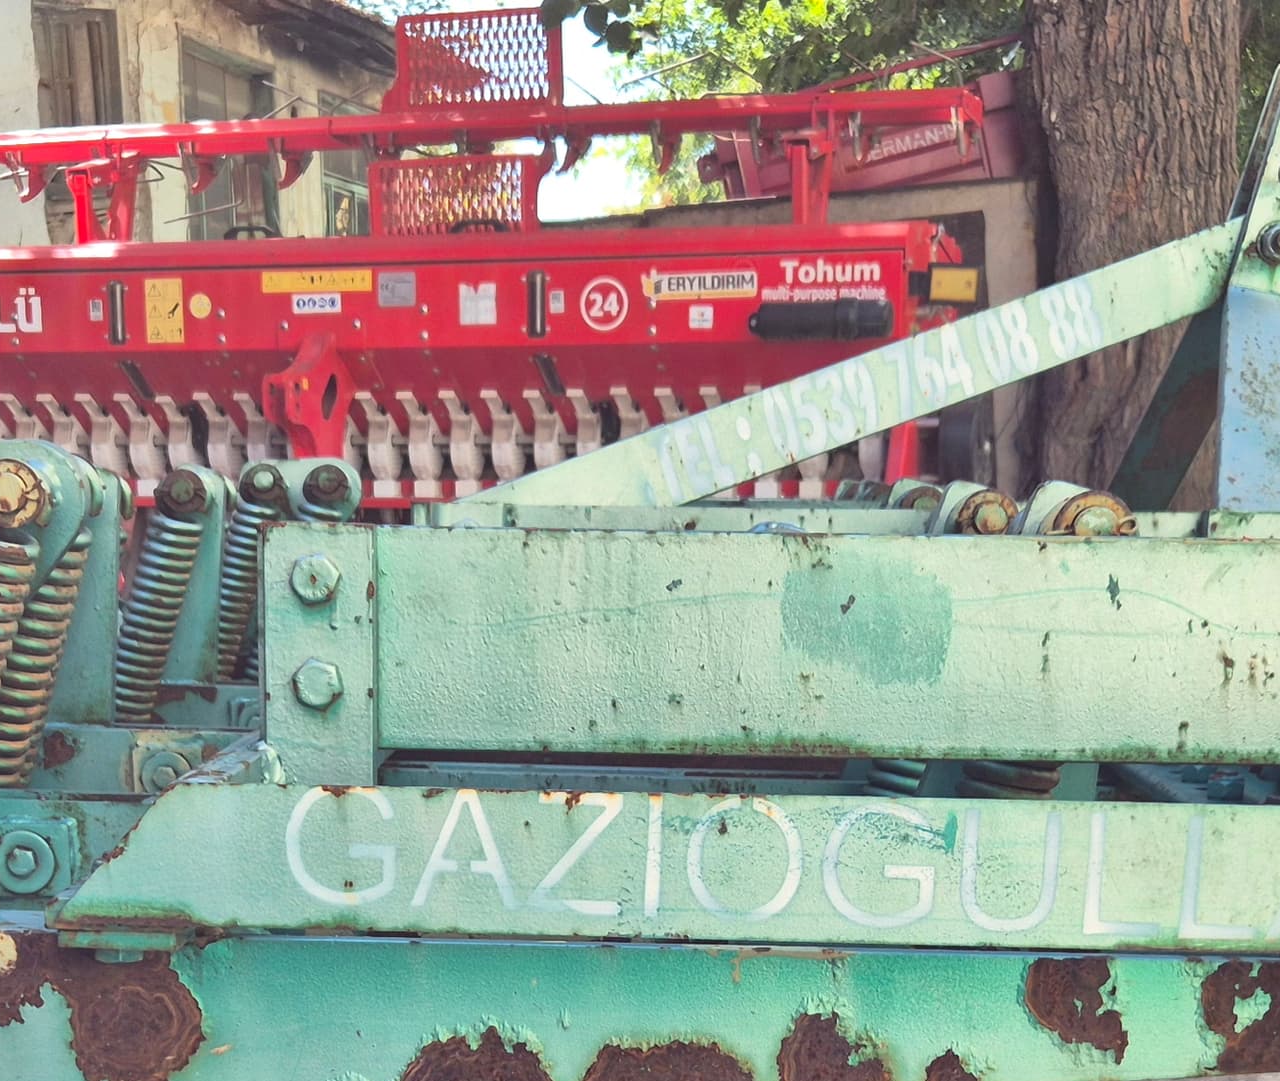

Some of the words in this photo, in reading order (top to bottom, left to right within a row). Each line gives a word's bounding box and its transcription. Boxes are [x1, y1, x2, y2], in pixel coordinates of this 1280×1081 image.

[667, 274, 755, 292] ERYILDIRIM
[780, 259, 881, 284] Tohum
[589, 291, 620, 318] 24
[761, 285, 837, 303] multi-purpose
[839, 285, 886, 300] machine
[763, 360, 877, 463] 0539
[884, 321, 976, 418] 764
[976, 300, 1039, 385] 08
[1039, 278, 1105, 362] 88
